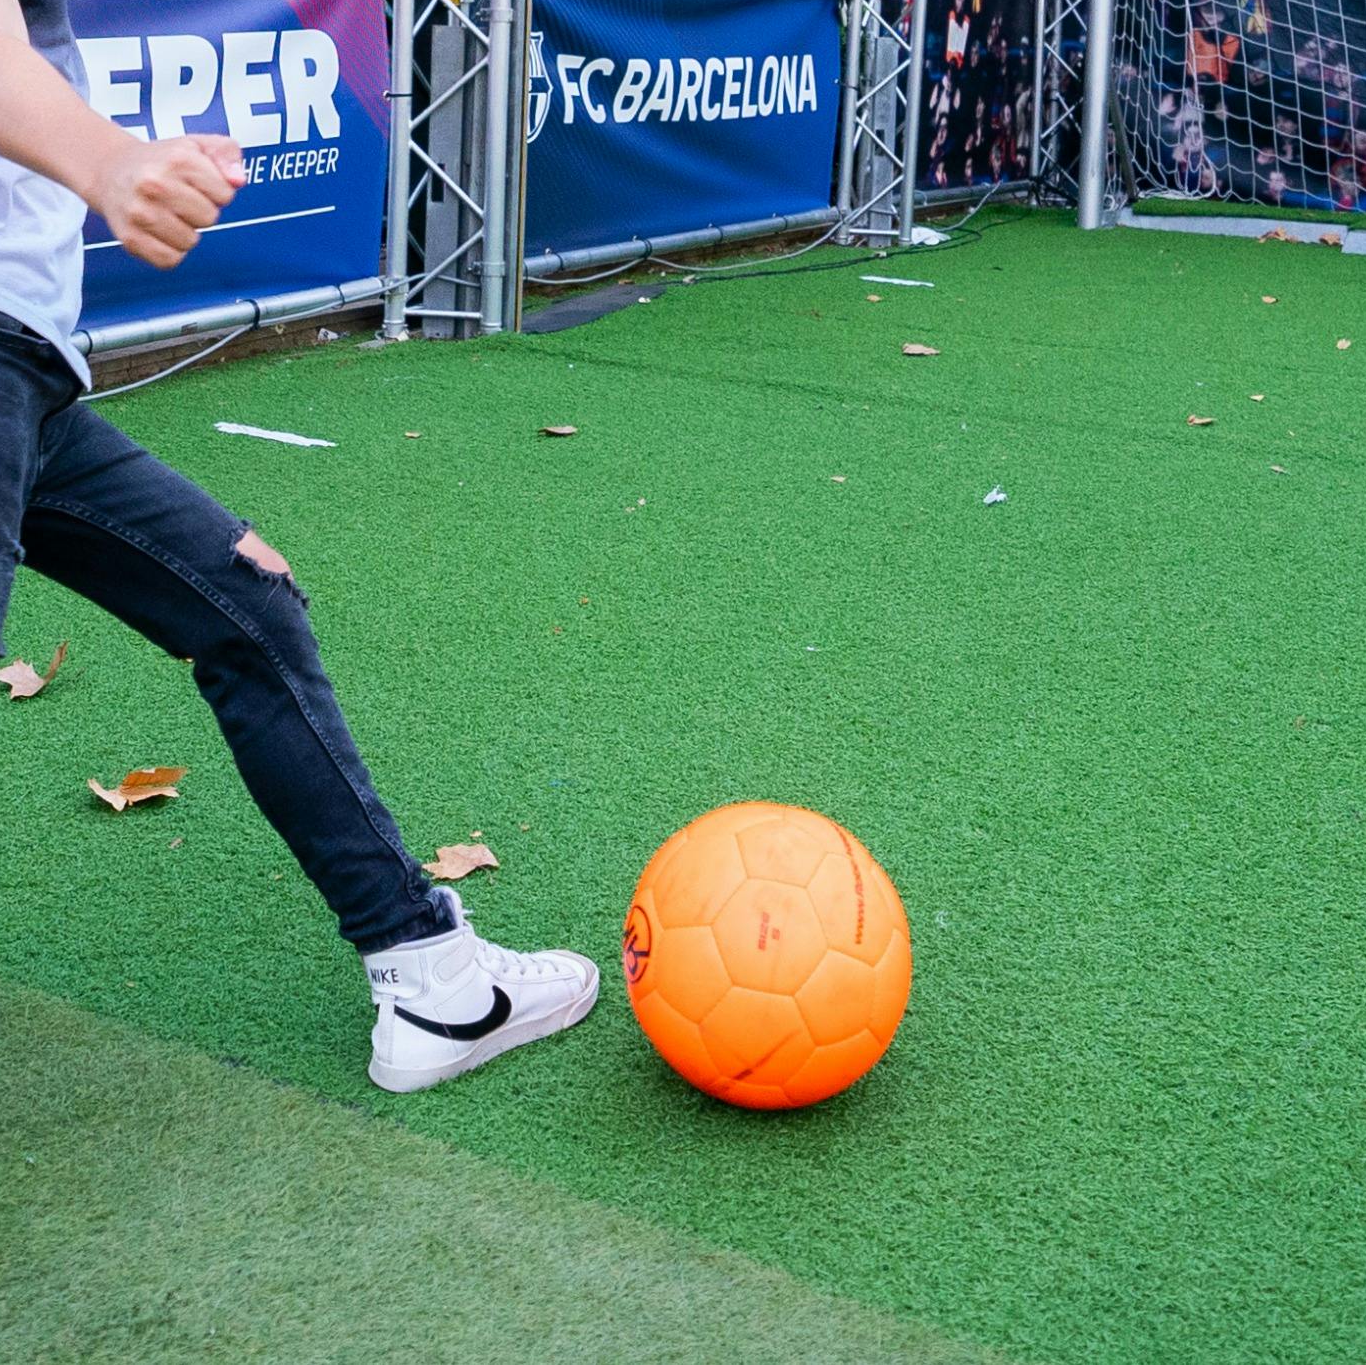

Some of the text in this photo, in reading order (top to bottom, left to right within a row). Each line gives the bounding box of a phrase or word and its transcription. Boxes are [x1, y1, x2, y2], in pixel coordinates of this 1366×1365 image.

[556, 53, 817, 124] FC BARCELONA
[242, 156, 267, 185] HE
[270, 147, 339, 182] KEEPER
[370, 968, 399, 984] NIKE
